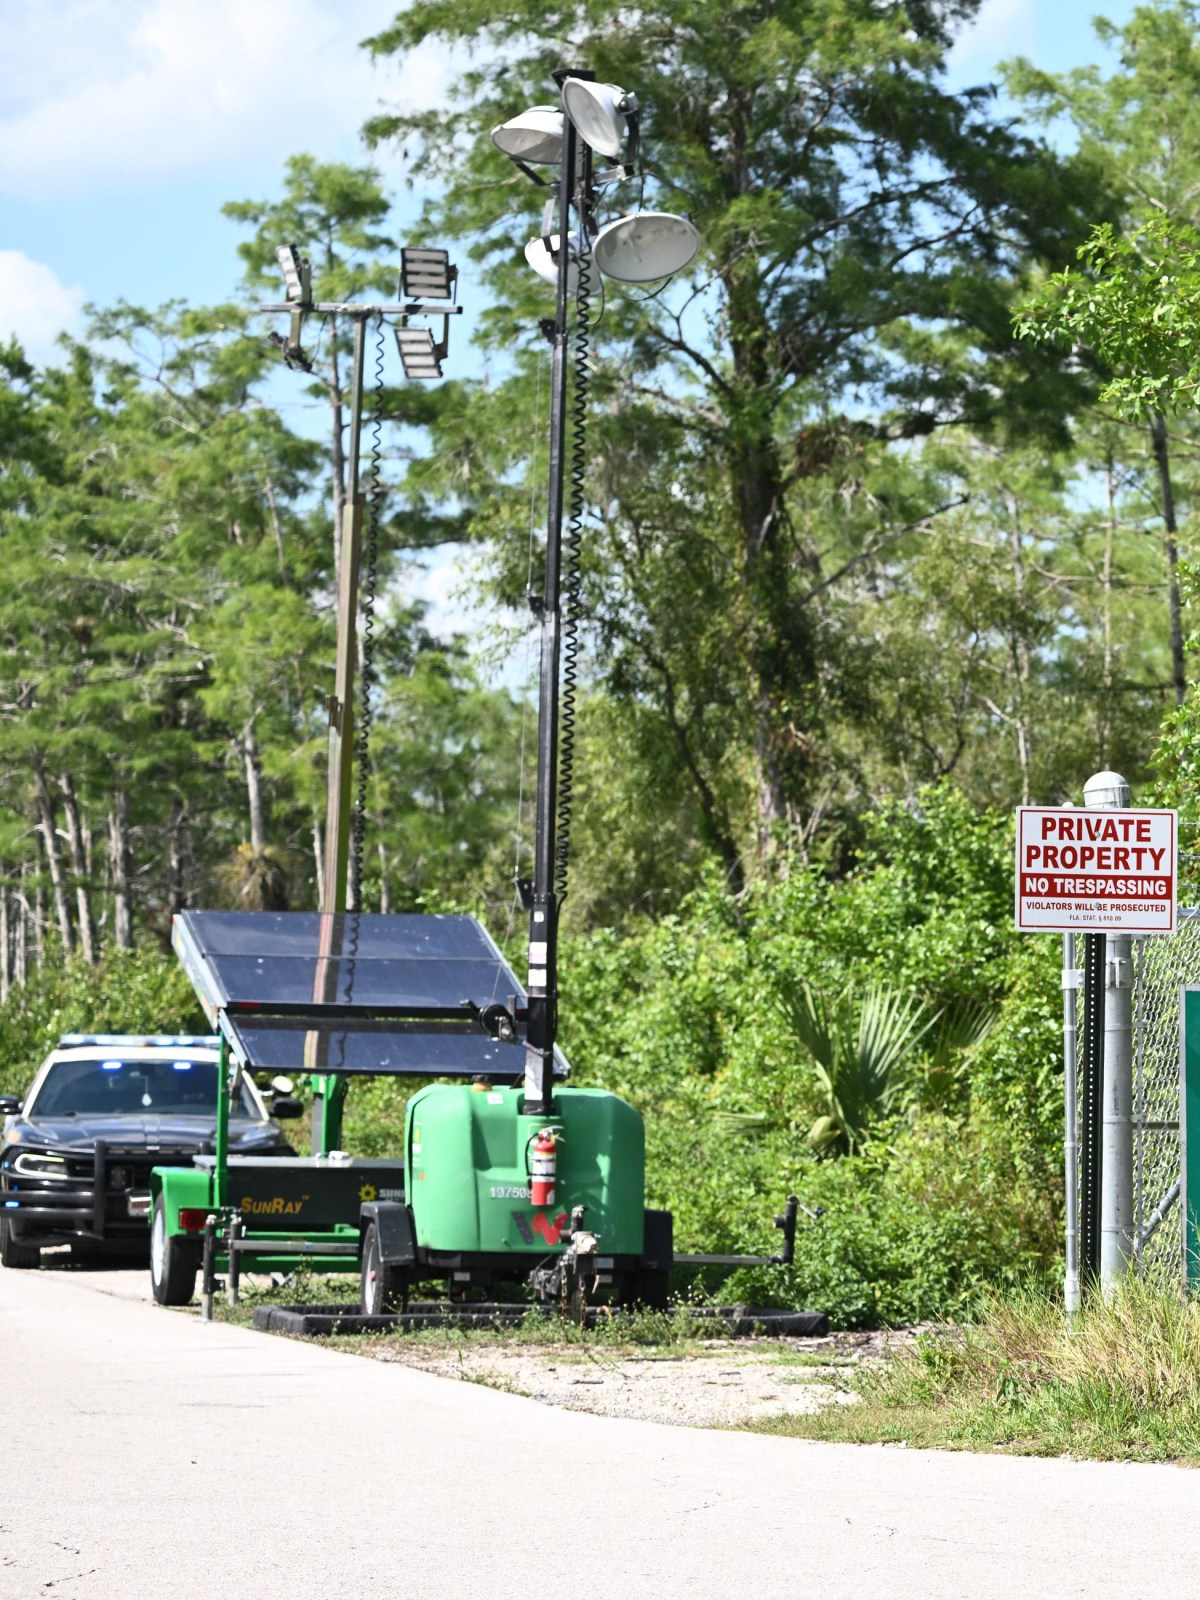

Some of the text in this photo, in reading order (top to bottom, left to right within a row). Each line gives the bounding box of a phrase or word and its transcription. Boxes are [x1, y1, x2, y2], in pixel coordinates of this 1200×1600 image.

[1041, 817, 1151, 842] PRIVATE
[1026, 845, 1166, 871] PROPERTY
[1025, 877, 1167, 895] NO TRESPASSING
[1026, 901, 1166, 912] VIOLATORS WILL BE PROSECUTED
